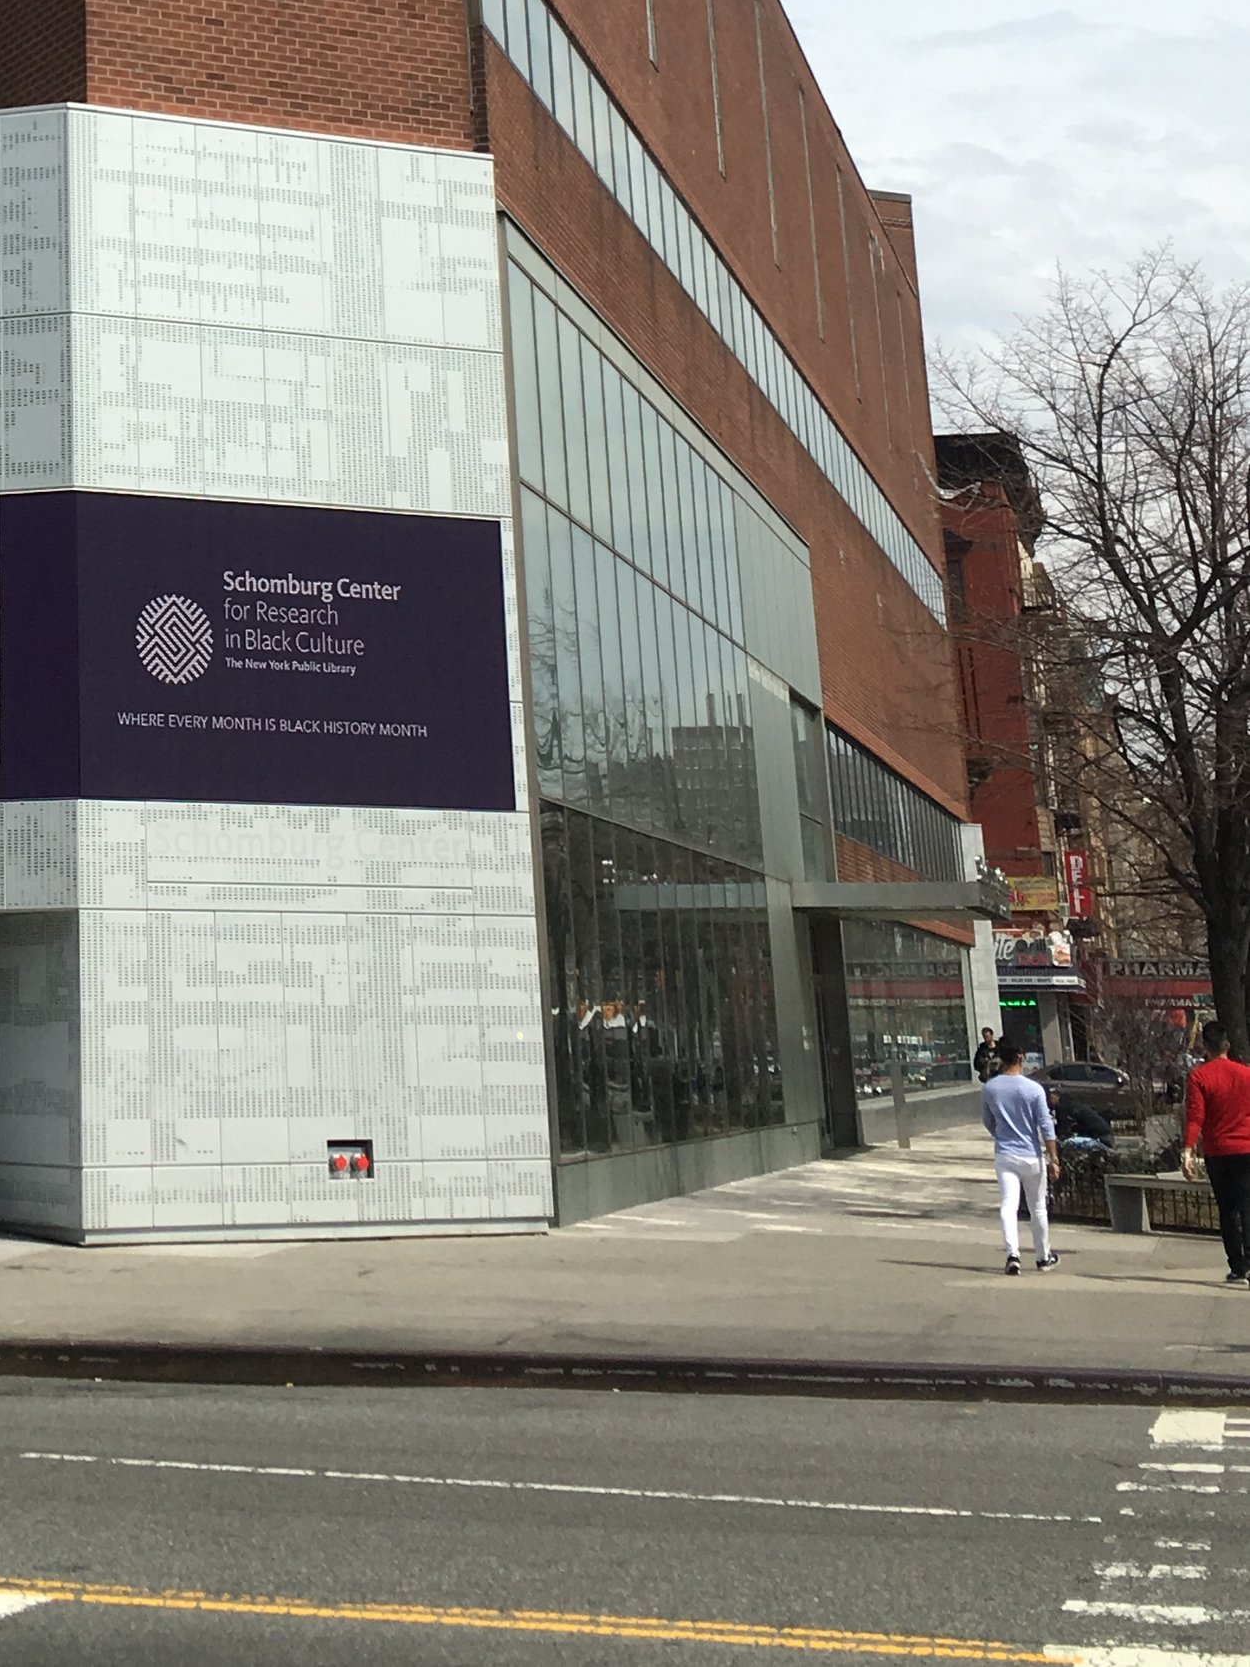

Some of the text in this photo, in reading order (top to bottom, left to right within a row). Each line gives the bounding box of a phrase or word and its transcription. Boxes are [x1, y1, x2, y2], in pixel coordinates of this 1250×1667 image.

[223, 570, 402, 602] Schomburg Center
[223, 598, 339, 625] for Research
[225, 629, 365, 655] in Black Culture
[225, 657, 356, 676] The New York Public Library
[117, 712, 427, 737] WHERE EVERY MONTH IS BLACK HISTORY MONTH
[151, 822, 465, 869] Schomburg Center
